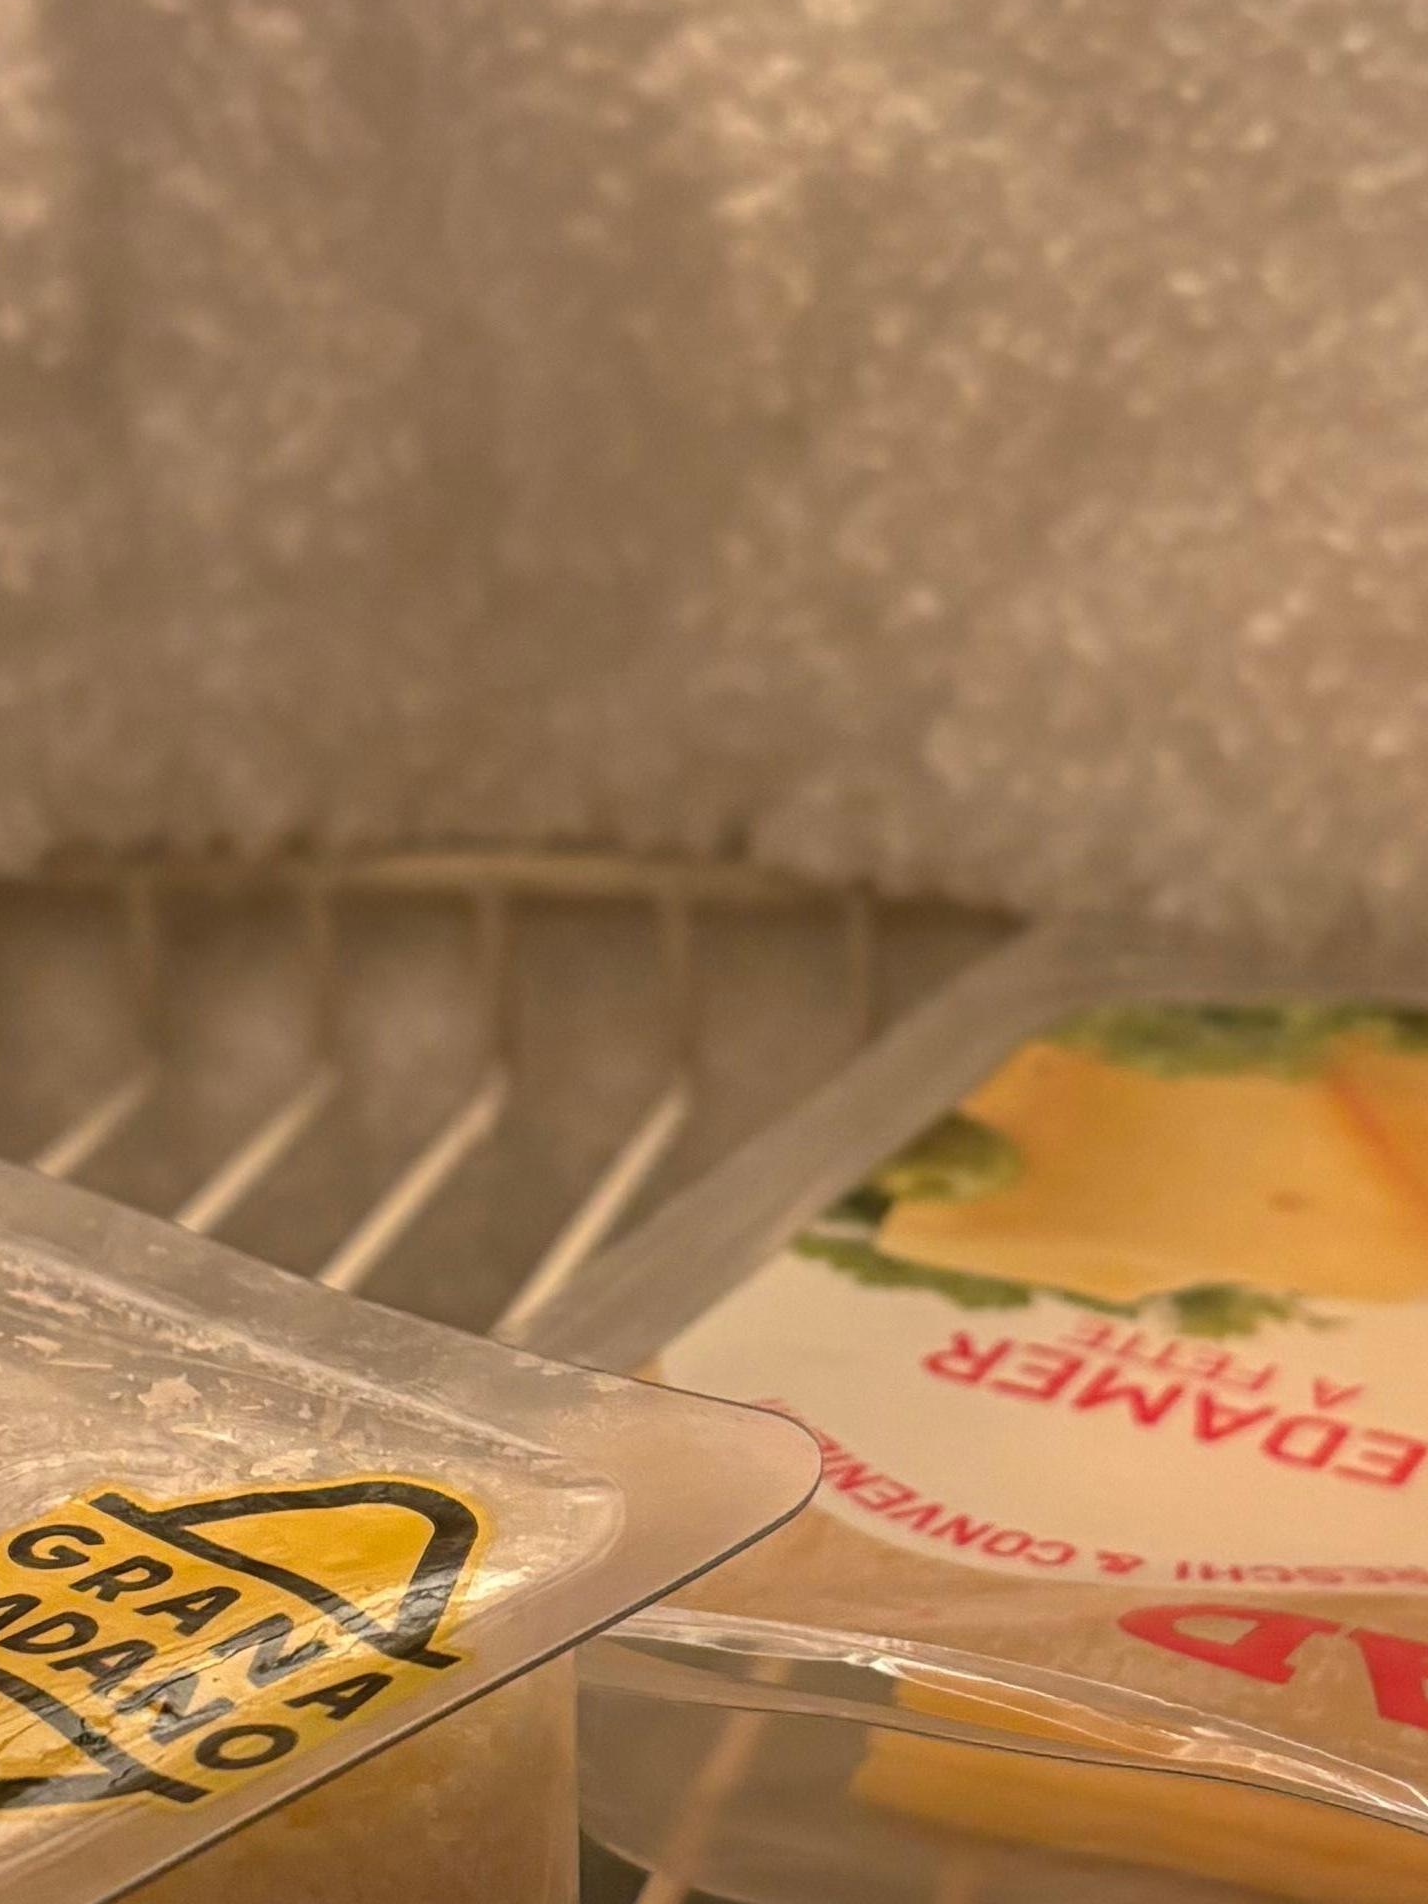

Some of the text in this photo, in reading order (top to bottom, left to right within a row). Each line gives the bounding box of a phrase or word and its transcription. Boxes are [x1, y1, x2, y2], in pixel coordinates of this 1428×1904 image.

[1065, 1312, 1368, 1413] A FETTE
[1093, 1548, 1144, 1575] &
[7, 1524, 395, 1722] GRANA
